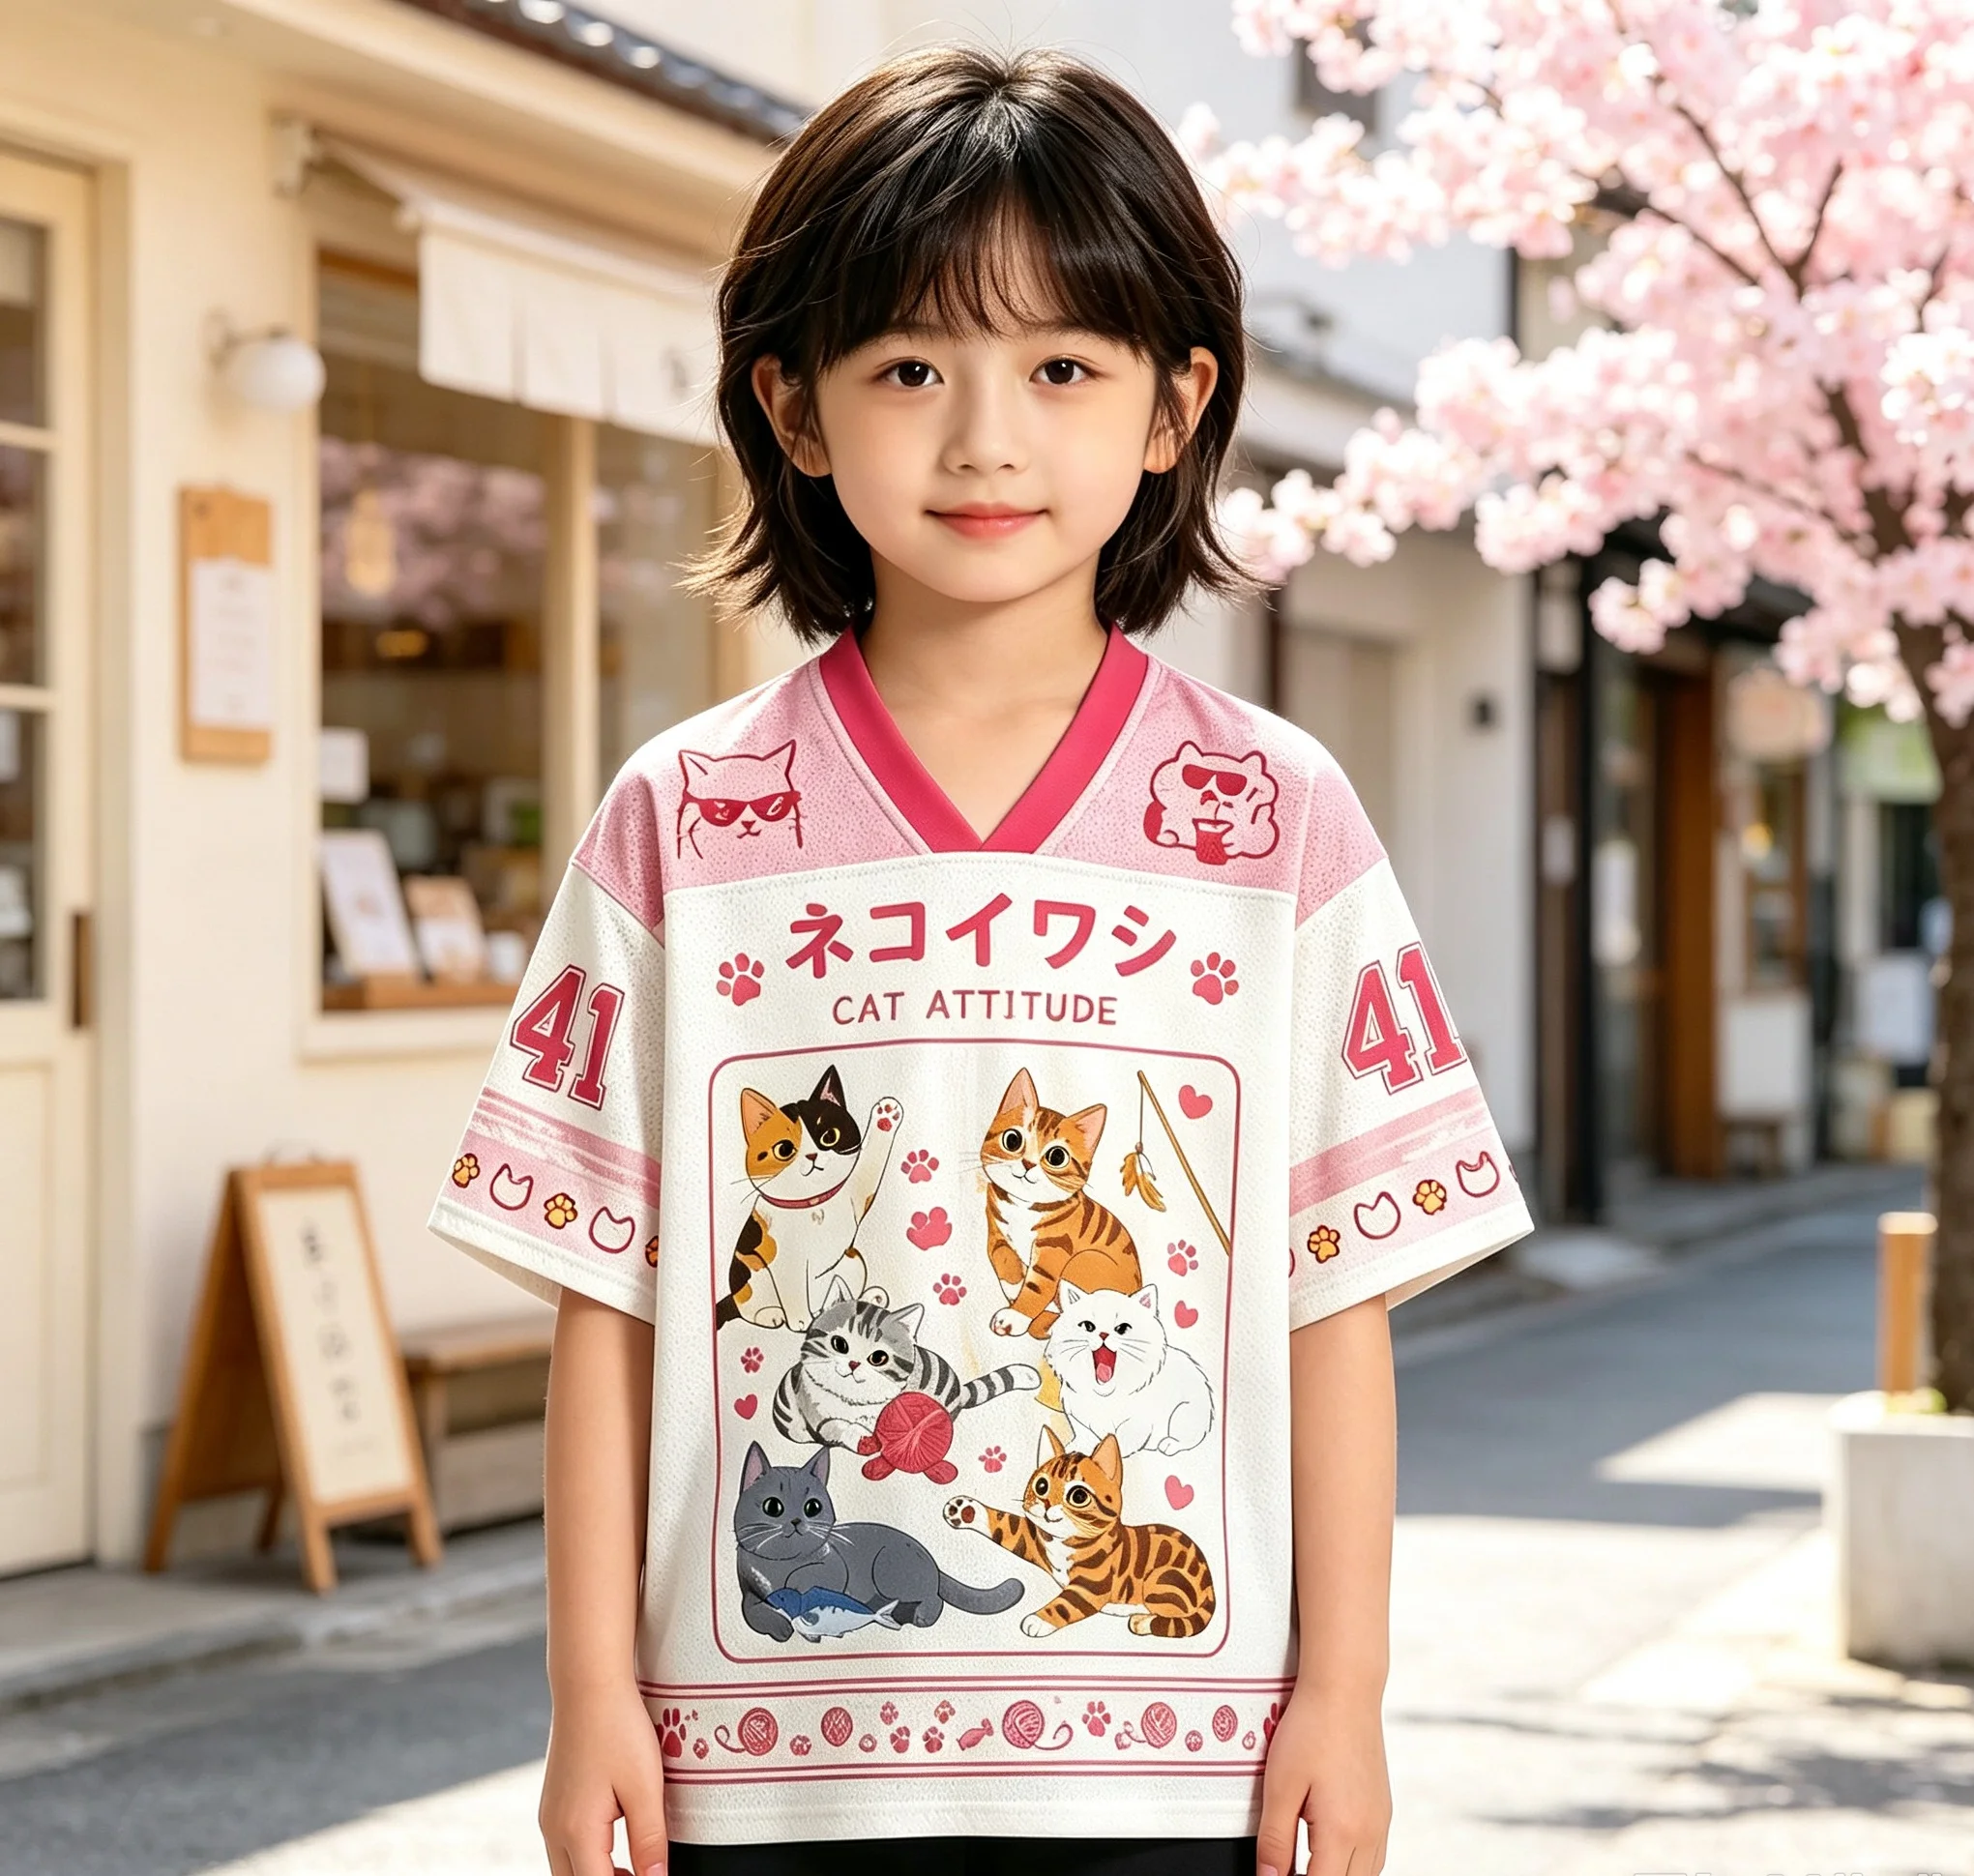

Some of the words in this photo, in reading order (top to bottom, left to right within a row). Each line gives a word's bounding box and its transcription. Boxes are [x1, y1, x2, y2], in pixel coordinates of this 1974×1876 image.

[784, 893, 1177, 979] ネコイワシ
[510, 963, 626, 1111] 41
[832, 991, 905, 1025] CAT
[926, 989, 1118, 1026] ATTITUDE
[1341, 941, 1468, 1096] 41
